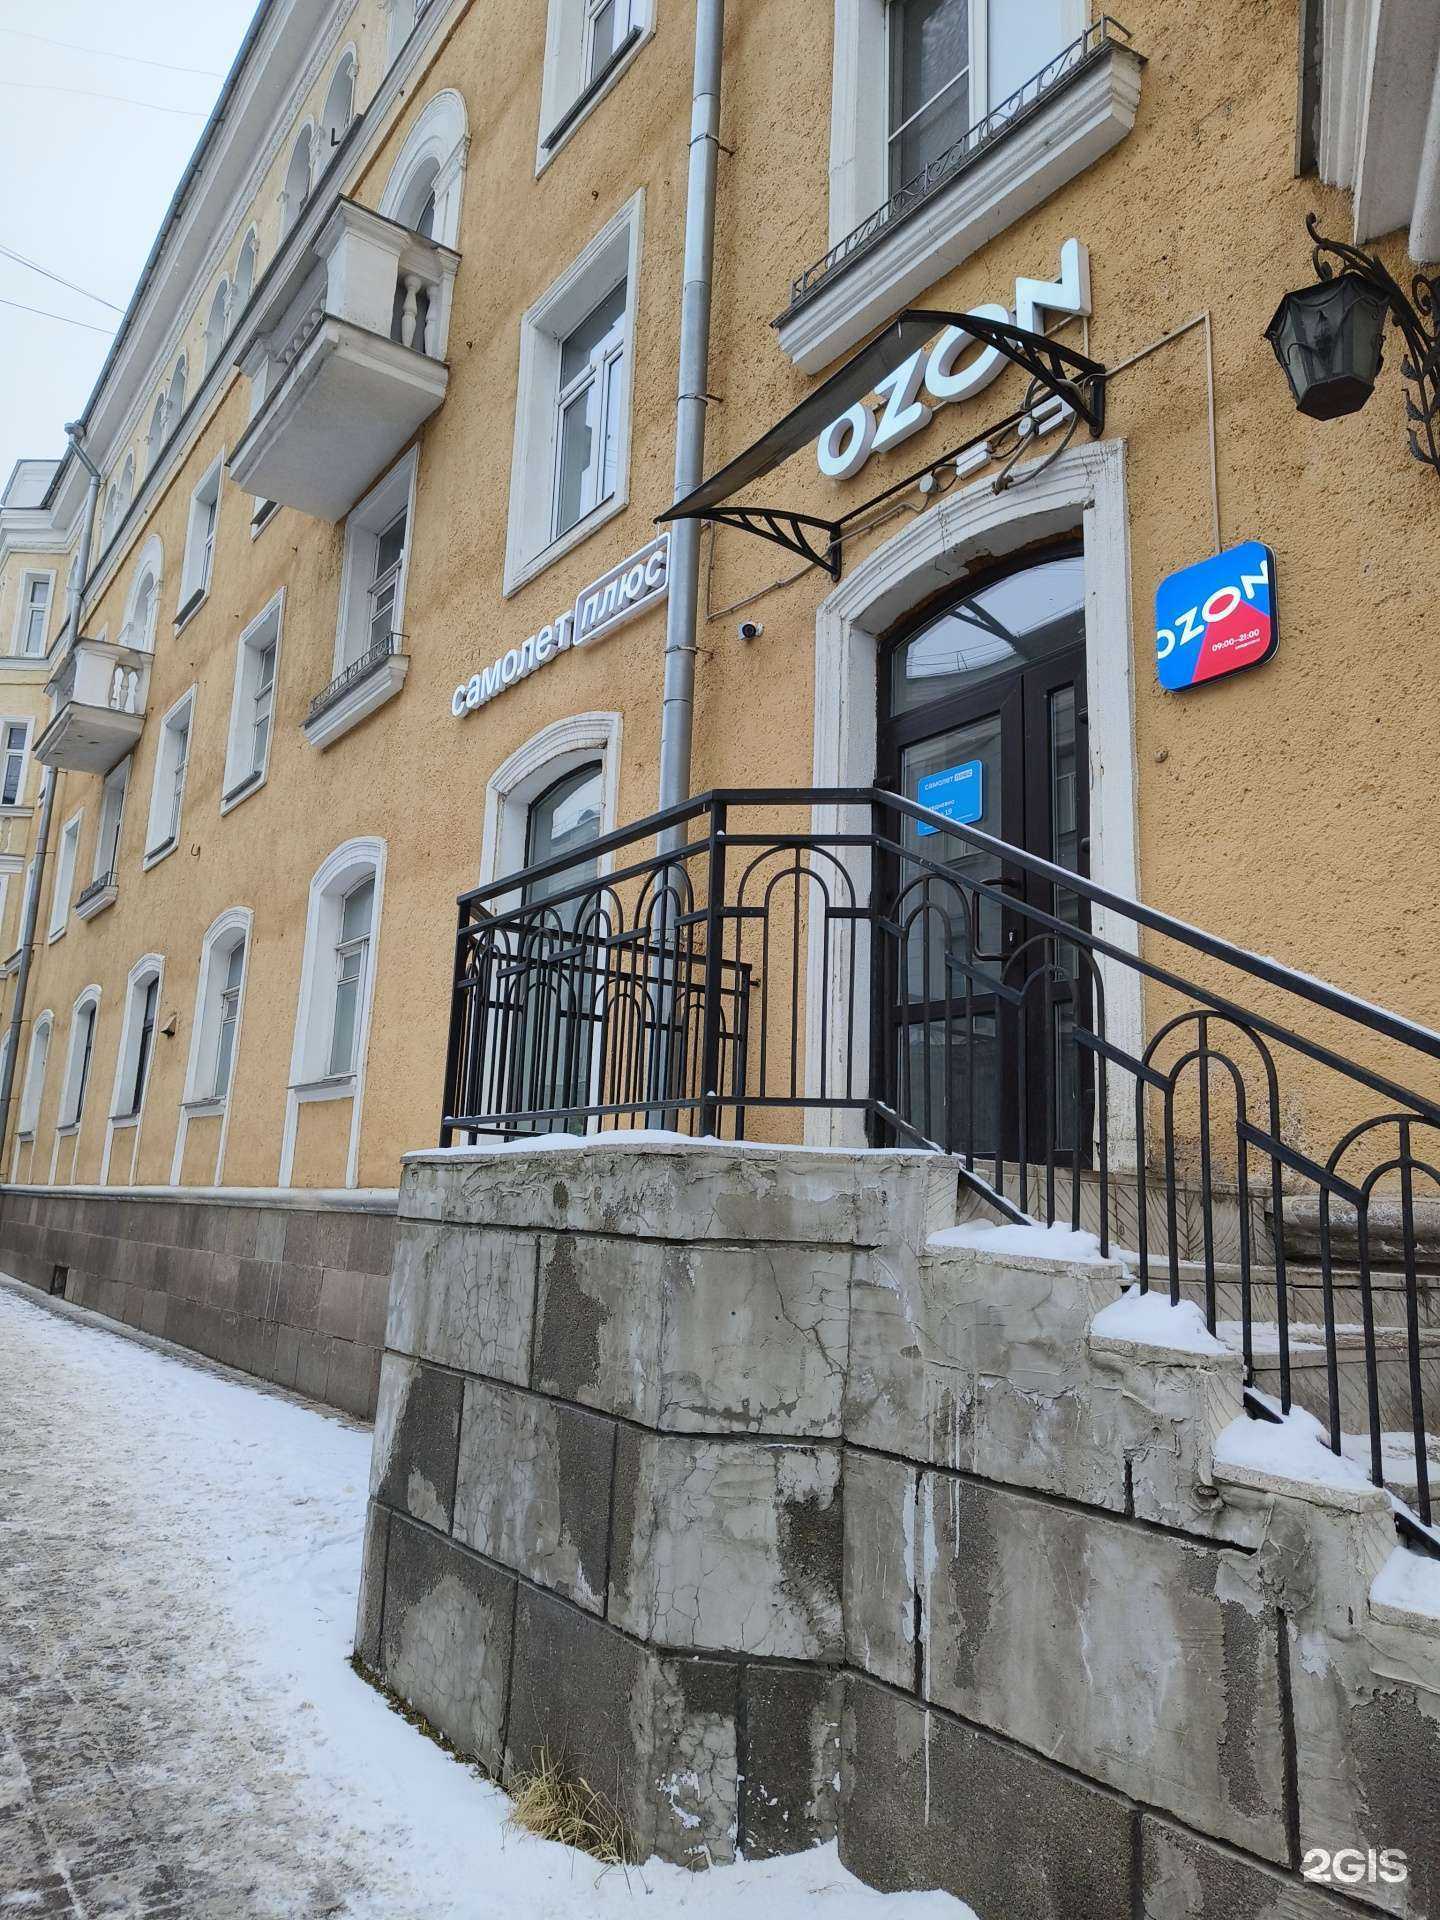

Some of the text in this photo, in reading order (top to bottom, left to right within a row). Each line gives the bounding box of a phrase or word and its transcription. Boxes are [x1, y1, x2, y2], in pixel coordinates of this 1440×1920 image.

[817, 237, 1088, 479] OZON
[452, 550, 667, 717] самолет плюс
[1157, 560, 1268, 660] OZON
